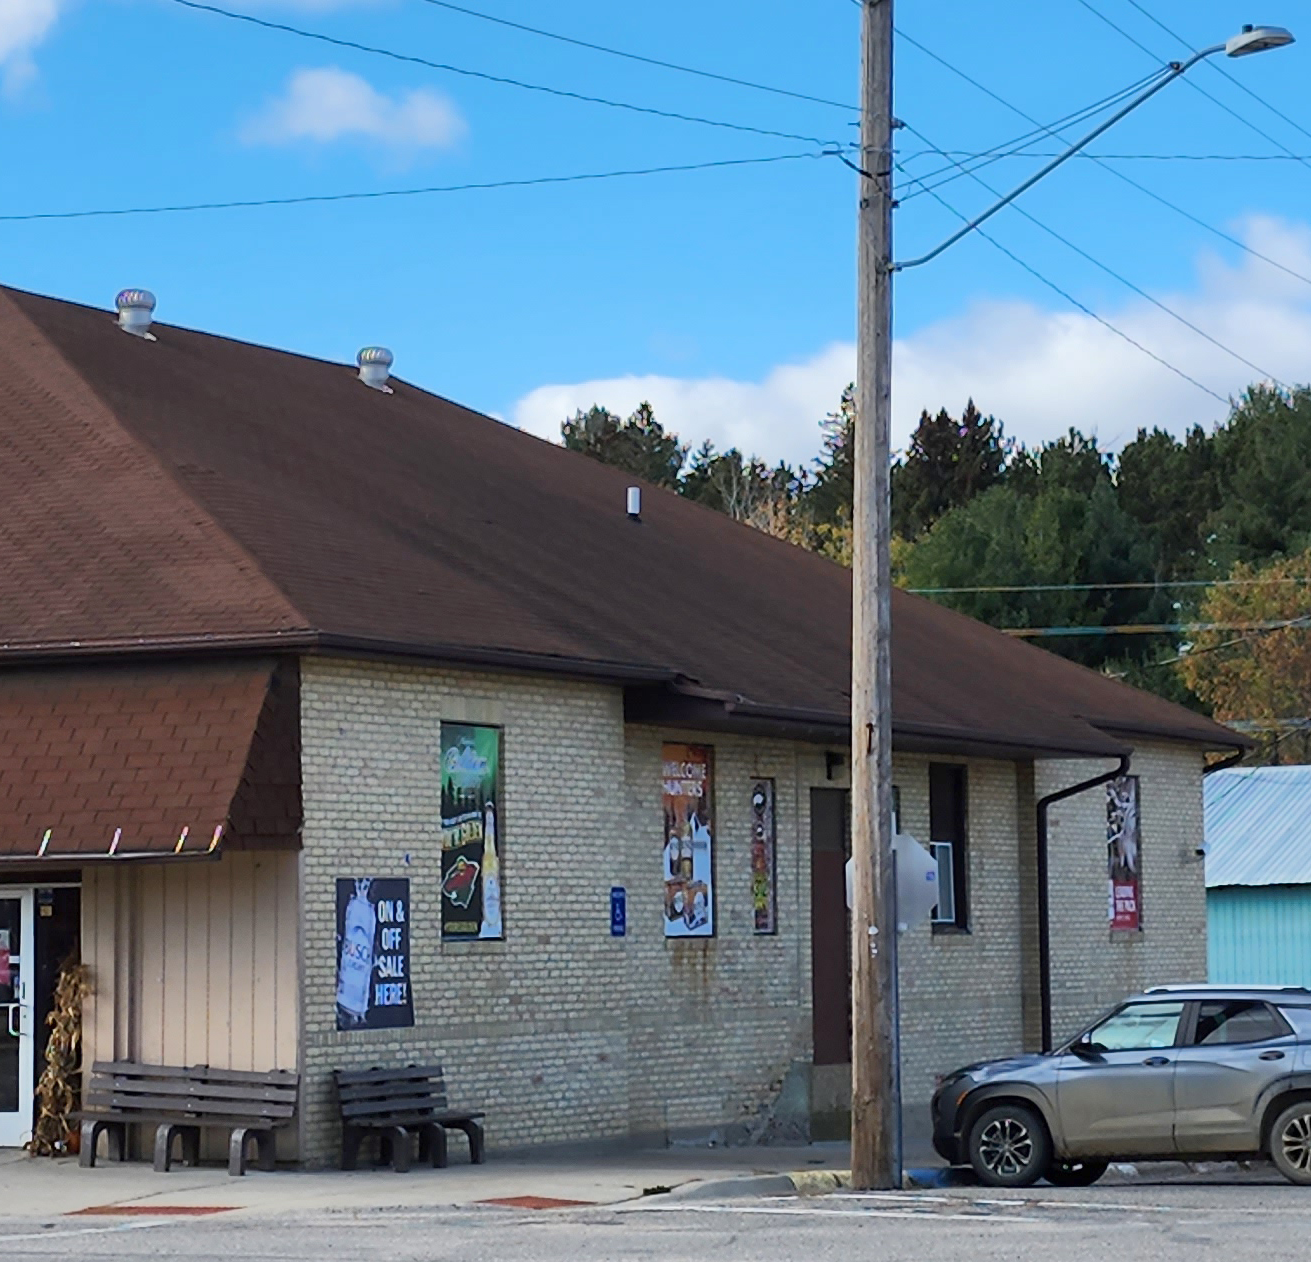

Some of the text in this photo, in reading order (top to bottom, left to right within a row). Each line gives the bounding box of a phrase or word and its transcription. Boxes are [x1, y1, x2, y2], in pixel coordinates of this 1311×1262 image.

[377, 900, 405, 924] ON &
[381, 927, 402, 951] OFF
[377, 955, 405, 979] SALE
[374, 982, 407, 1006] HERE!
